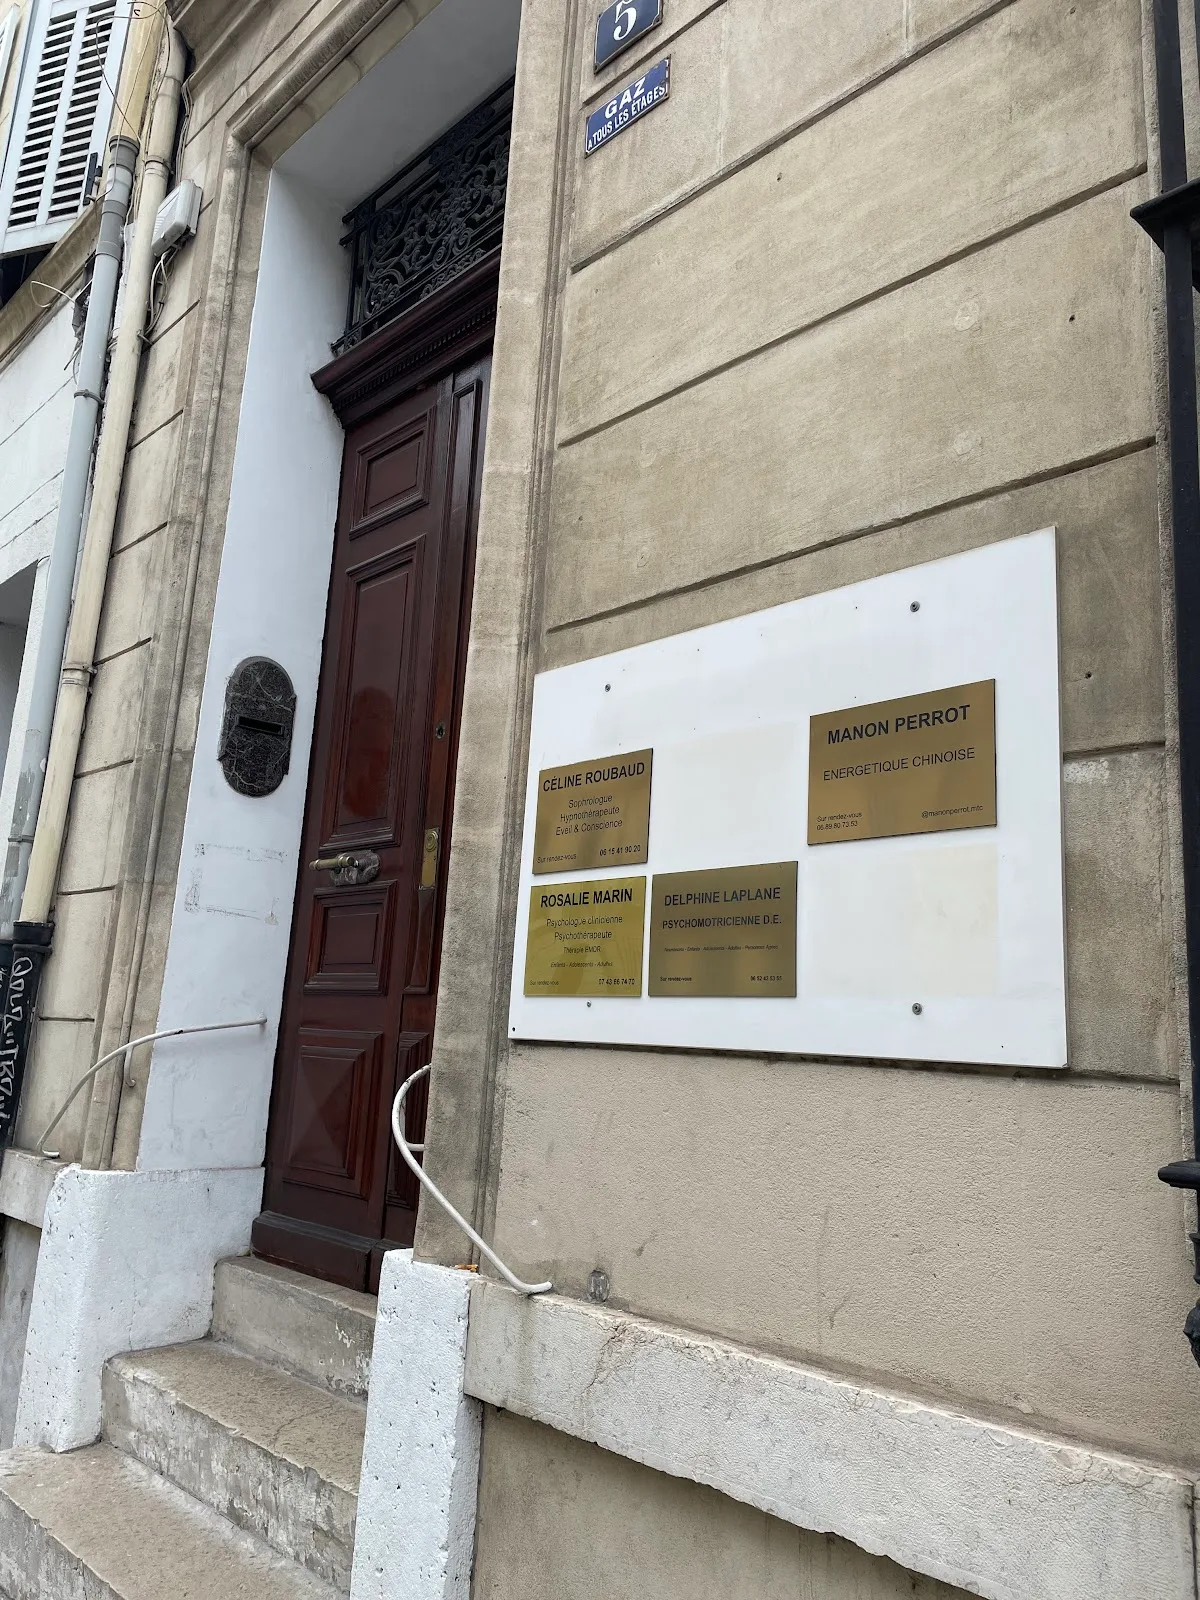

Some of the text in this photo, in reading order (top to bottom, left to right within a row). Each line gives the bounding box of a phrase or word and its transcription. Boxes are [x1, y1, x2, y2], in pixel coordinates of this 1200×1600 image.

[614, 0, 637, 40] 5
[604, 77, 646, 119] GAZ
[592, 122, 612, 146] TOUS
[614, 109, 629, 128] LES
[632, 86, 665, 116] ÉTAGES
[827, 704, 970, 744] MANON PERROT
[823, 748, 975, 781] ENERGETIQUE CHINOISE
[543, 762, 645, 792] CÉLINE ROUBAUD
[568, 794, 613, 808] Sophrologue
[560, 806, 620, 824] Hypnothérapeute
[828, 812, 862, 822] rendez-vous
[556, 820, 622, 836] Eveil & Conscience
[546, 853, 577, 862] rendez-vous
[540, 888, 632, 908] ROSALIE MARIN
[664, 886, 780, 906] DELPHINE LAPLANE
[546, 916, 622, 928] Psychologue clinicienne
[662, 914, 782, 929] PSYCHOMOTRICIENNE D.E.
[554, 930, 612, 942] Psychothérapeute
